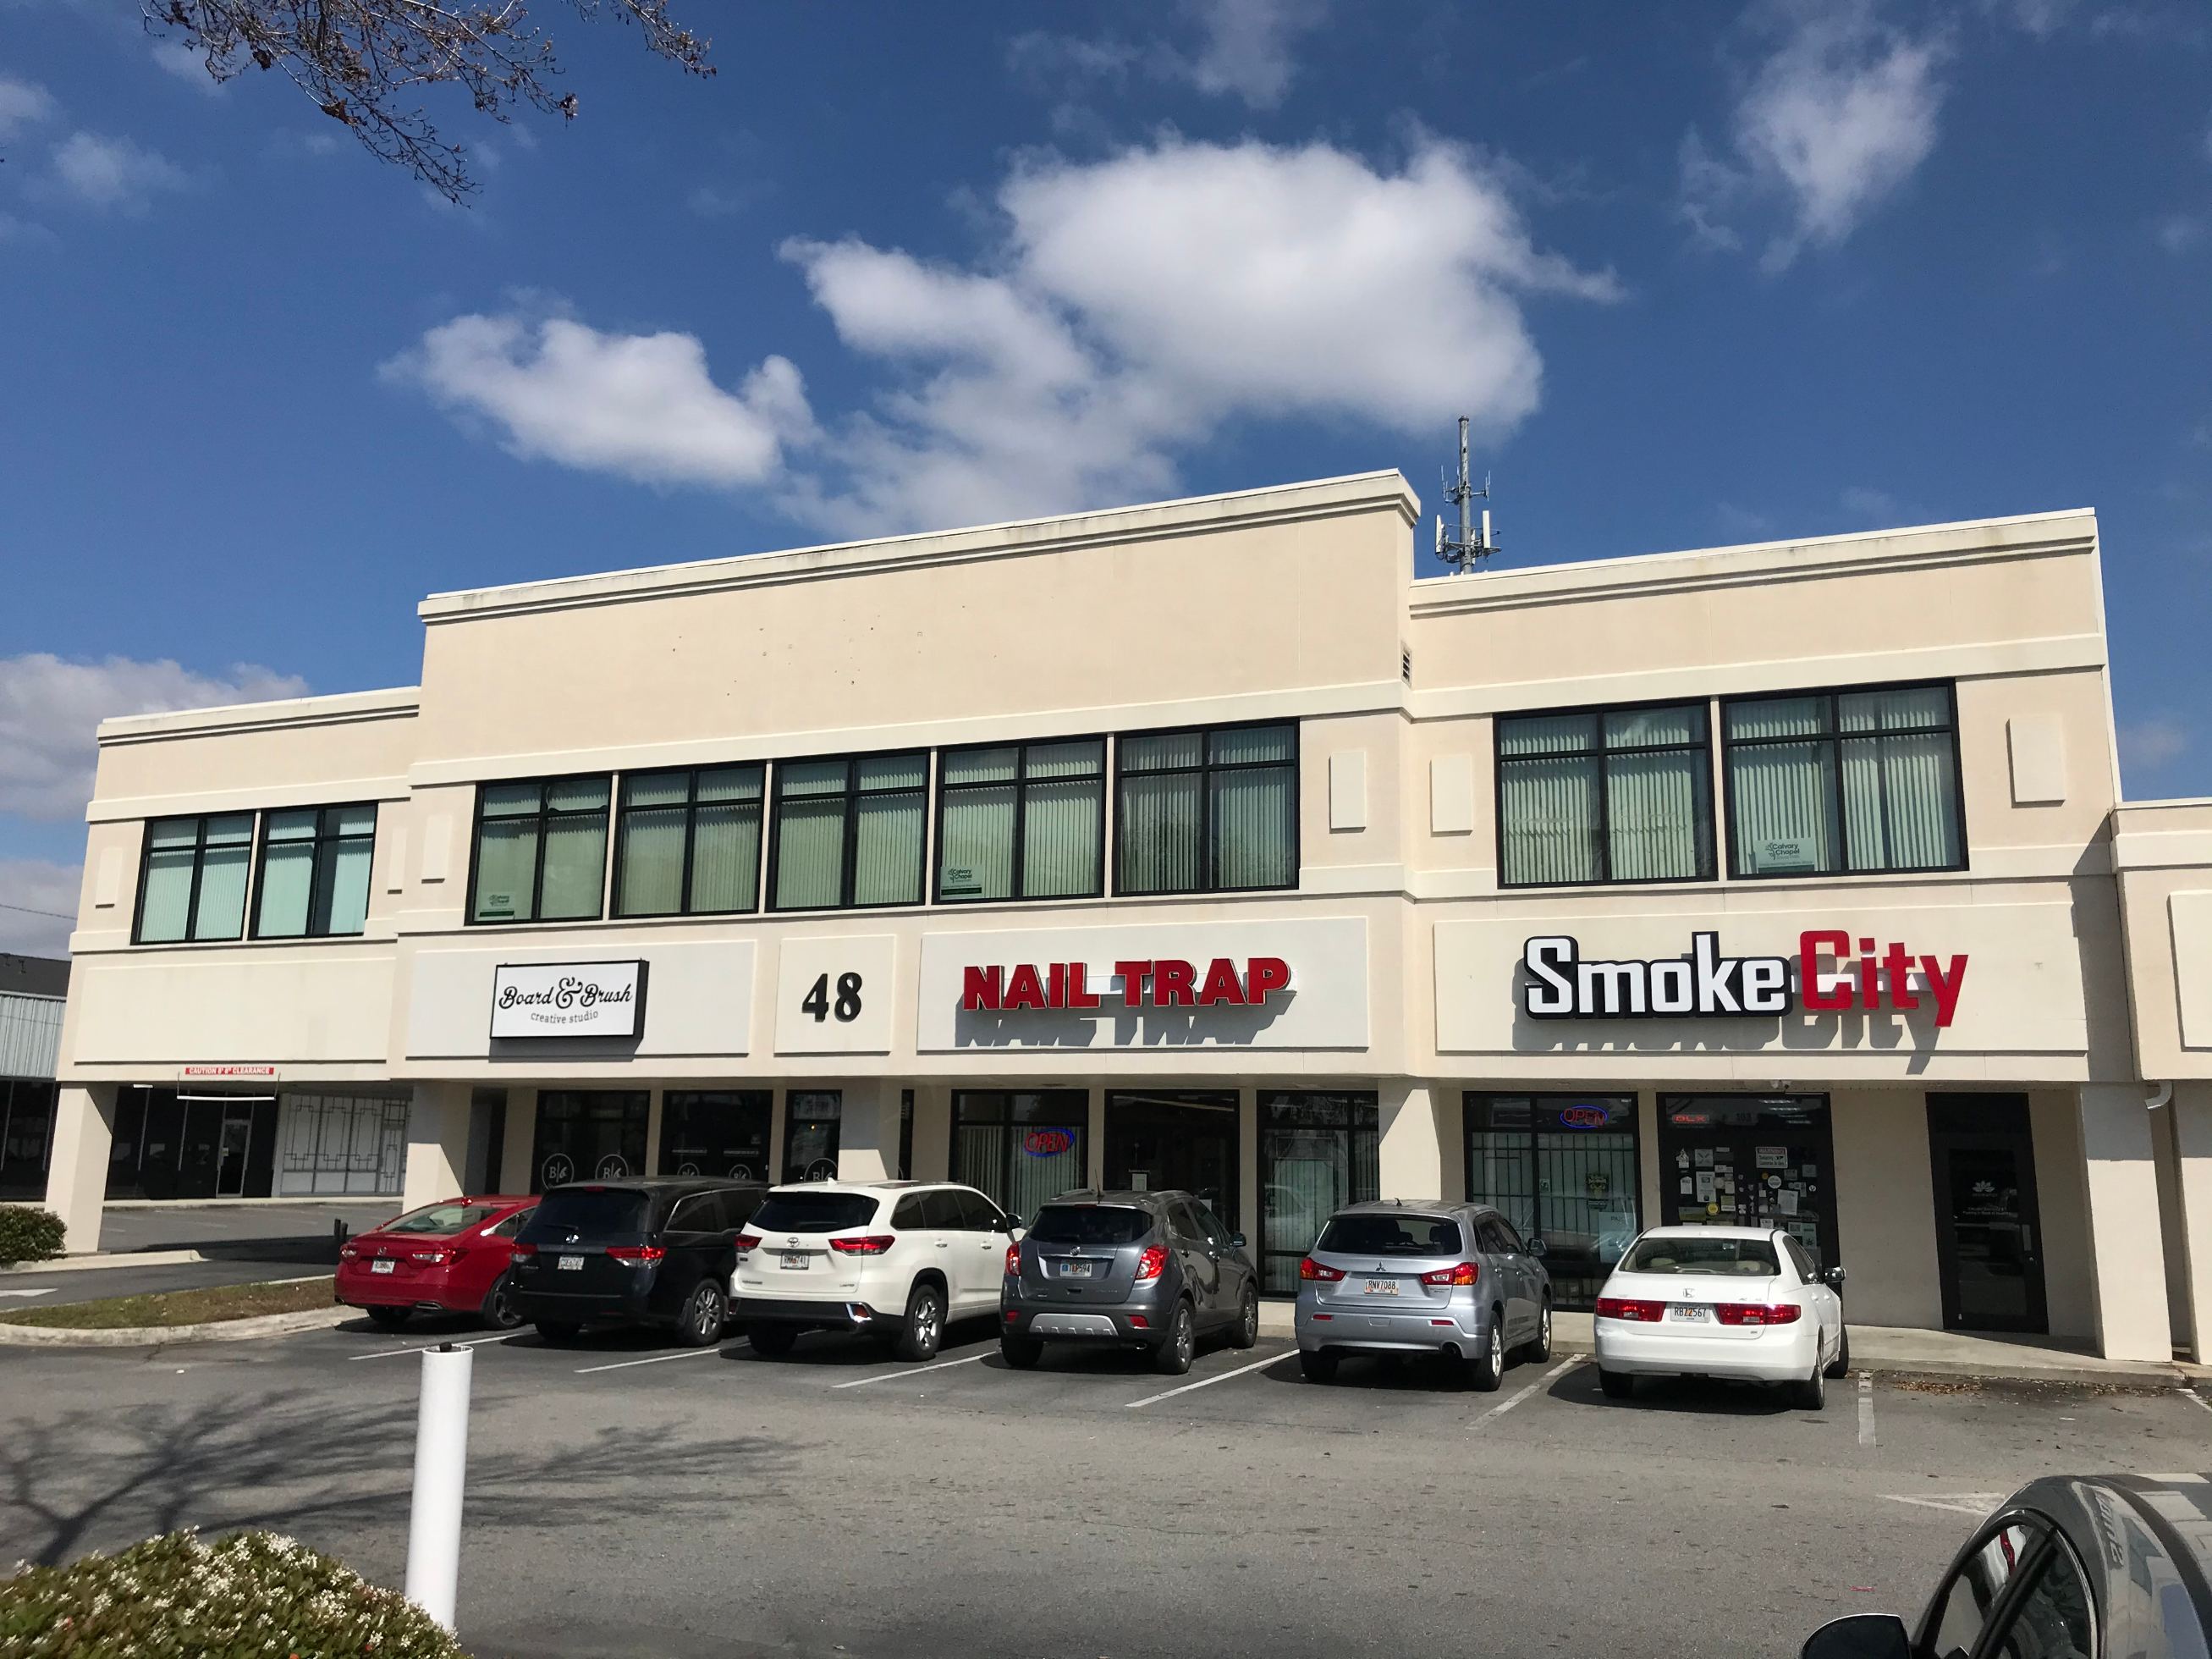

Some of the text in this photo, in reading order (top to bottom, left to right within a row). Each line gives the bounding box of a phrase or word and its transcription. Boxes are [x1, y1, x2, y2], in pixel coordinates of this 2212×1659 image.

[963, 957, 1290, 1010] NAIL TRAP
[1525, 930, 1969, 1028] Smoke City
[498, 977, 632, 1010] Board & Brush
[801, 972, 863, 1023] 48
[531, 1009, 599, 1024] creative studio
[1562, 1109, 1605, 1126] OPEN
[1025, 1132, 1070, 1152] OPEN
[1368, 1280, 1396, 1290] RNV7088
[1674, 1307, 1707, 1318] RBZ2567
